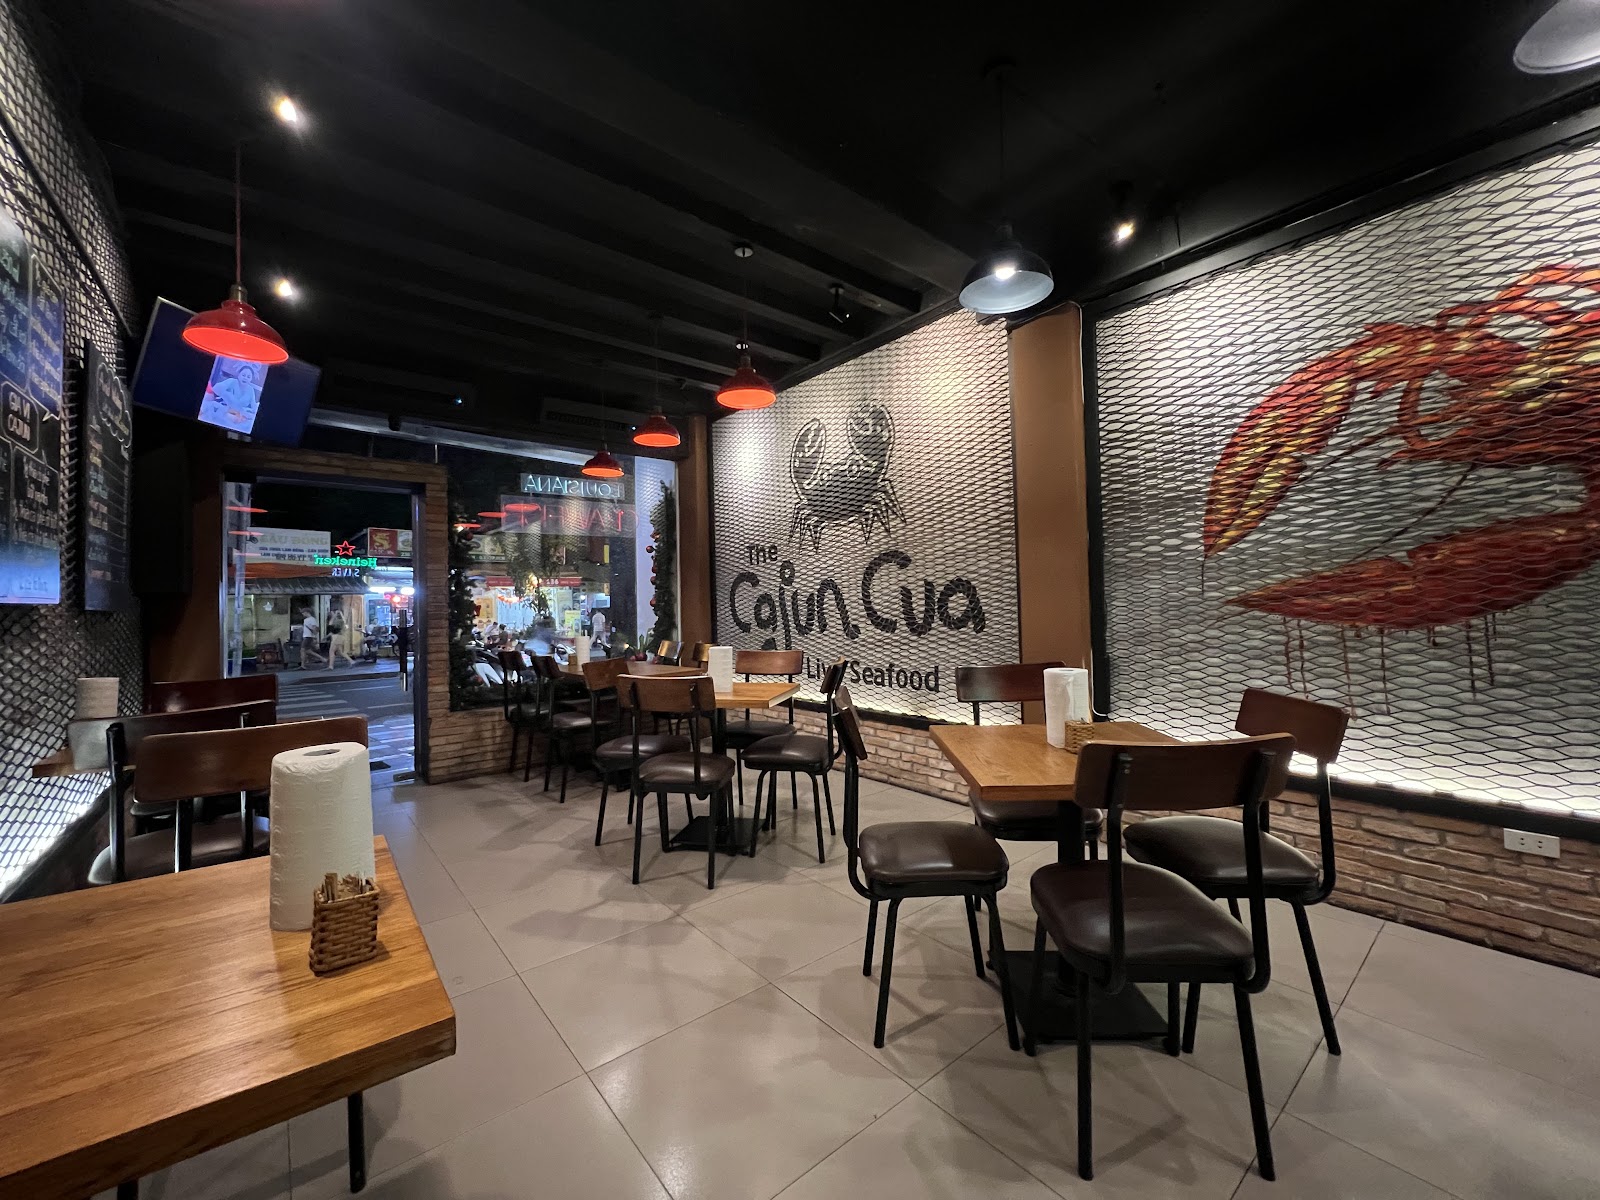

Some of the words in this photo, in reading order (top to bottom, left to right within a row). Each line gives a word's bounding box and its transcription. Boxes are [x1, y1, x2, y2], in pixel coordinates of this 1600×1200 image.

[746, 543, 778, 565] The
[730, 560, 861, 650] Cajun
[861, 551, 986, 636] Cua
[850, 660, 940, 693] Seafood
